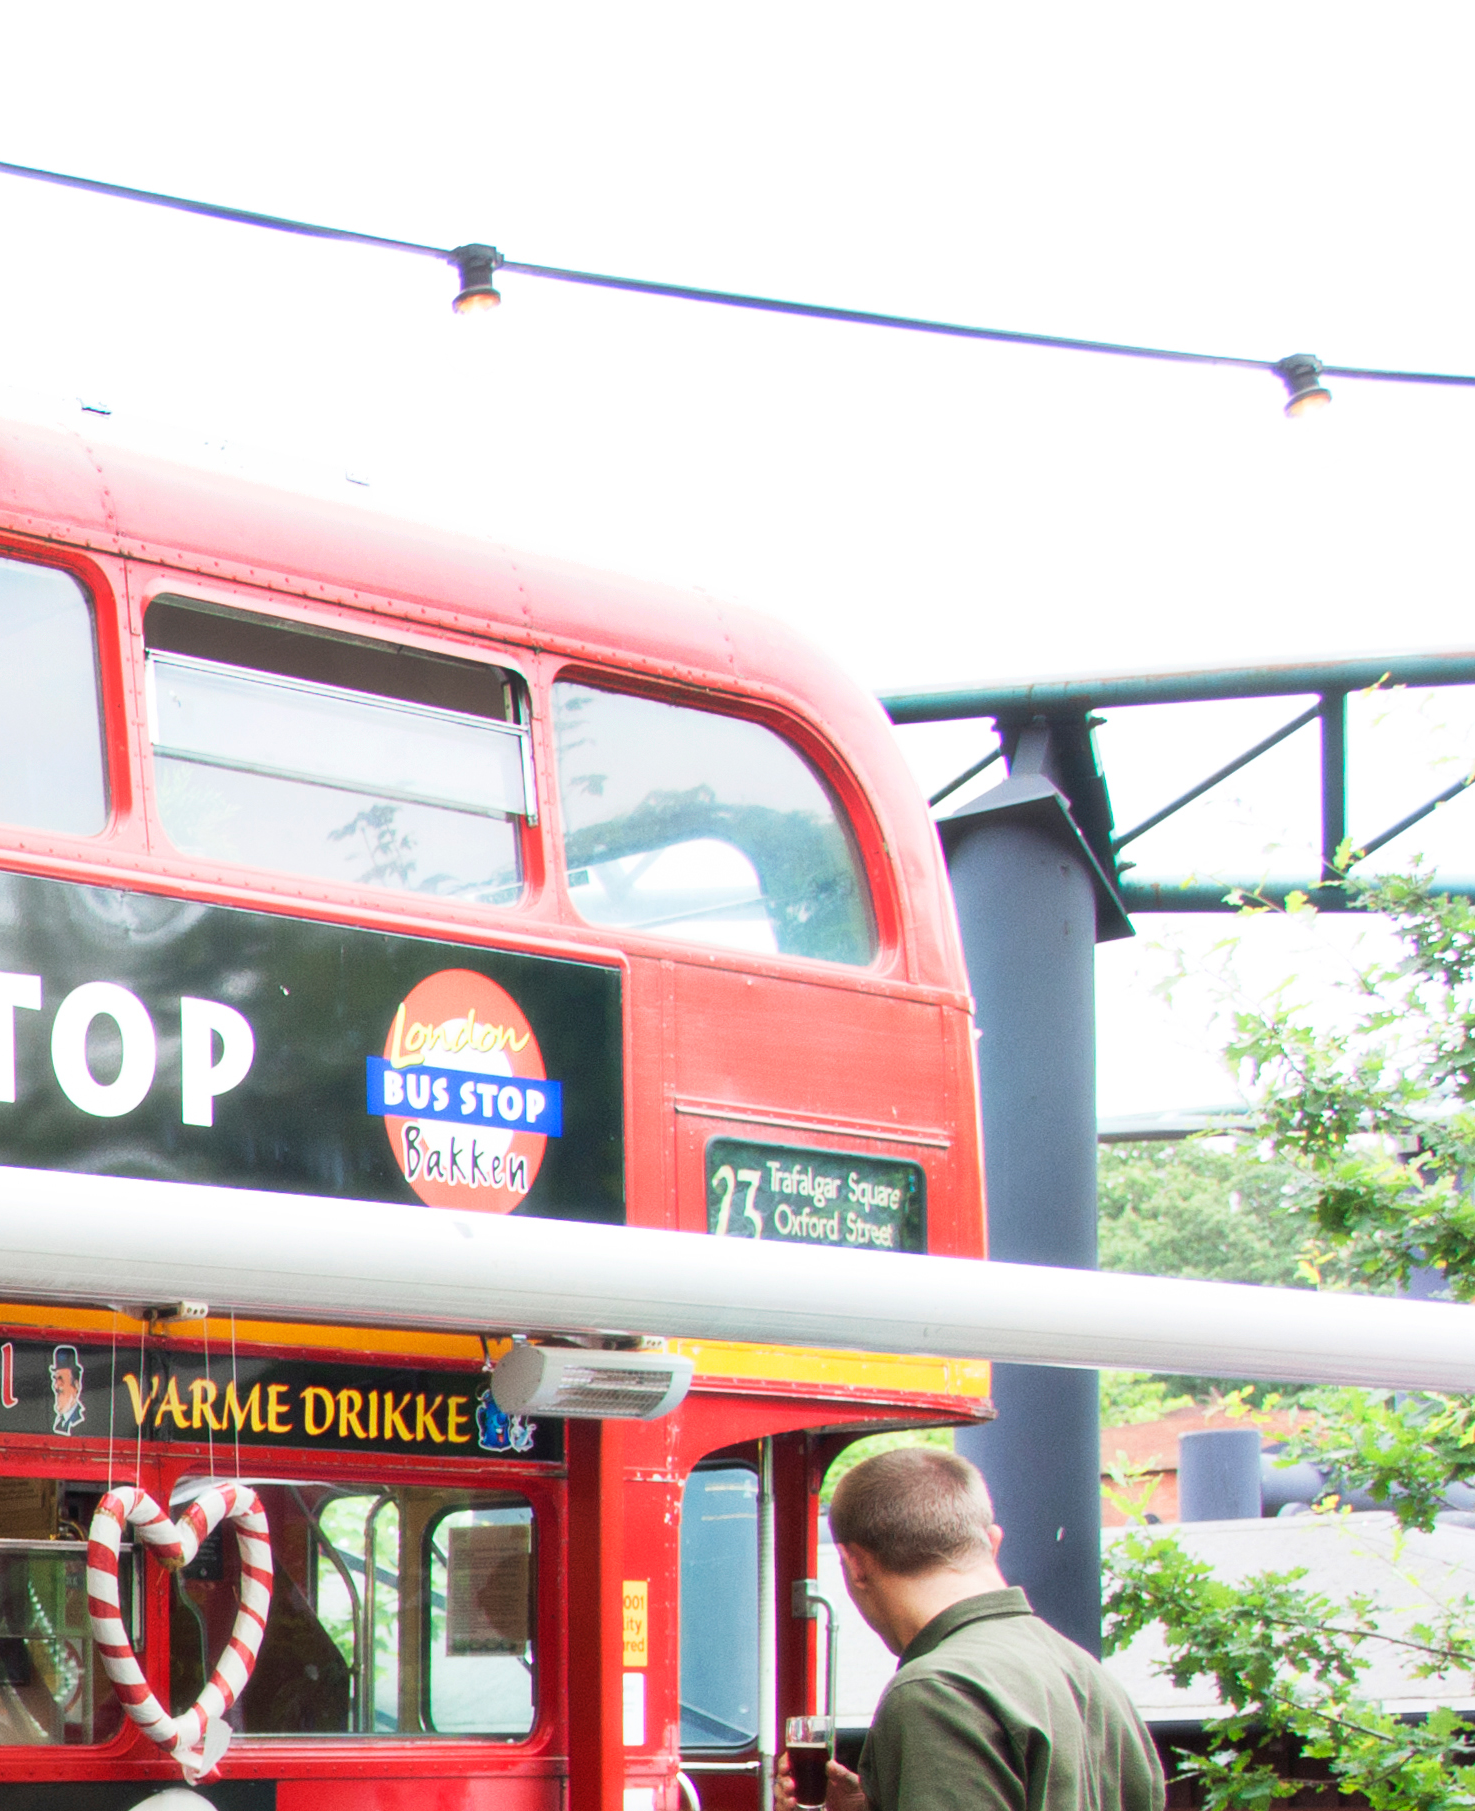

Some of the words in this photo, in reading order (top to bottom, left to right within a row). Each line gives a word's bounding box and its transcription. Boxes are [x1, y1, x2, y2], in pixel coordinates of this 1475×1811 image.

[390, 1003, 530, 1068] London
[383, 1070, 449, 1112] BUS
[460, 1081, 546, 1125] STOP
[402, 1124, 528, 1193] Bakken
[711, 1164, 763, 1240] 23
[766, 1161, 841, 1208] Trafalgar
[848, 1172, 902, 1213] Square
[774, 1203, 839, 1241] Oxford
[846, 1212, 893, 1247] Street
[123, 1374, 293, 1433] VARME
[300, 1387, 471, 1444] DRIKKE
[623, 1594, 645, 1610] 001
[623, 1615, 642, 1634] ity
